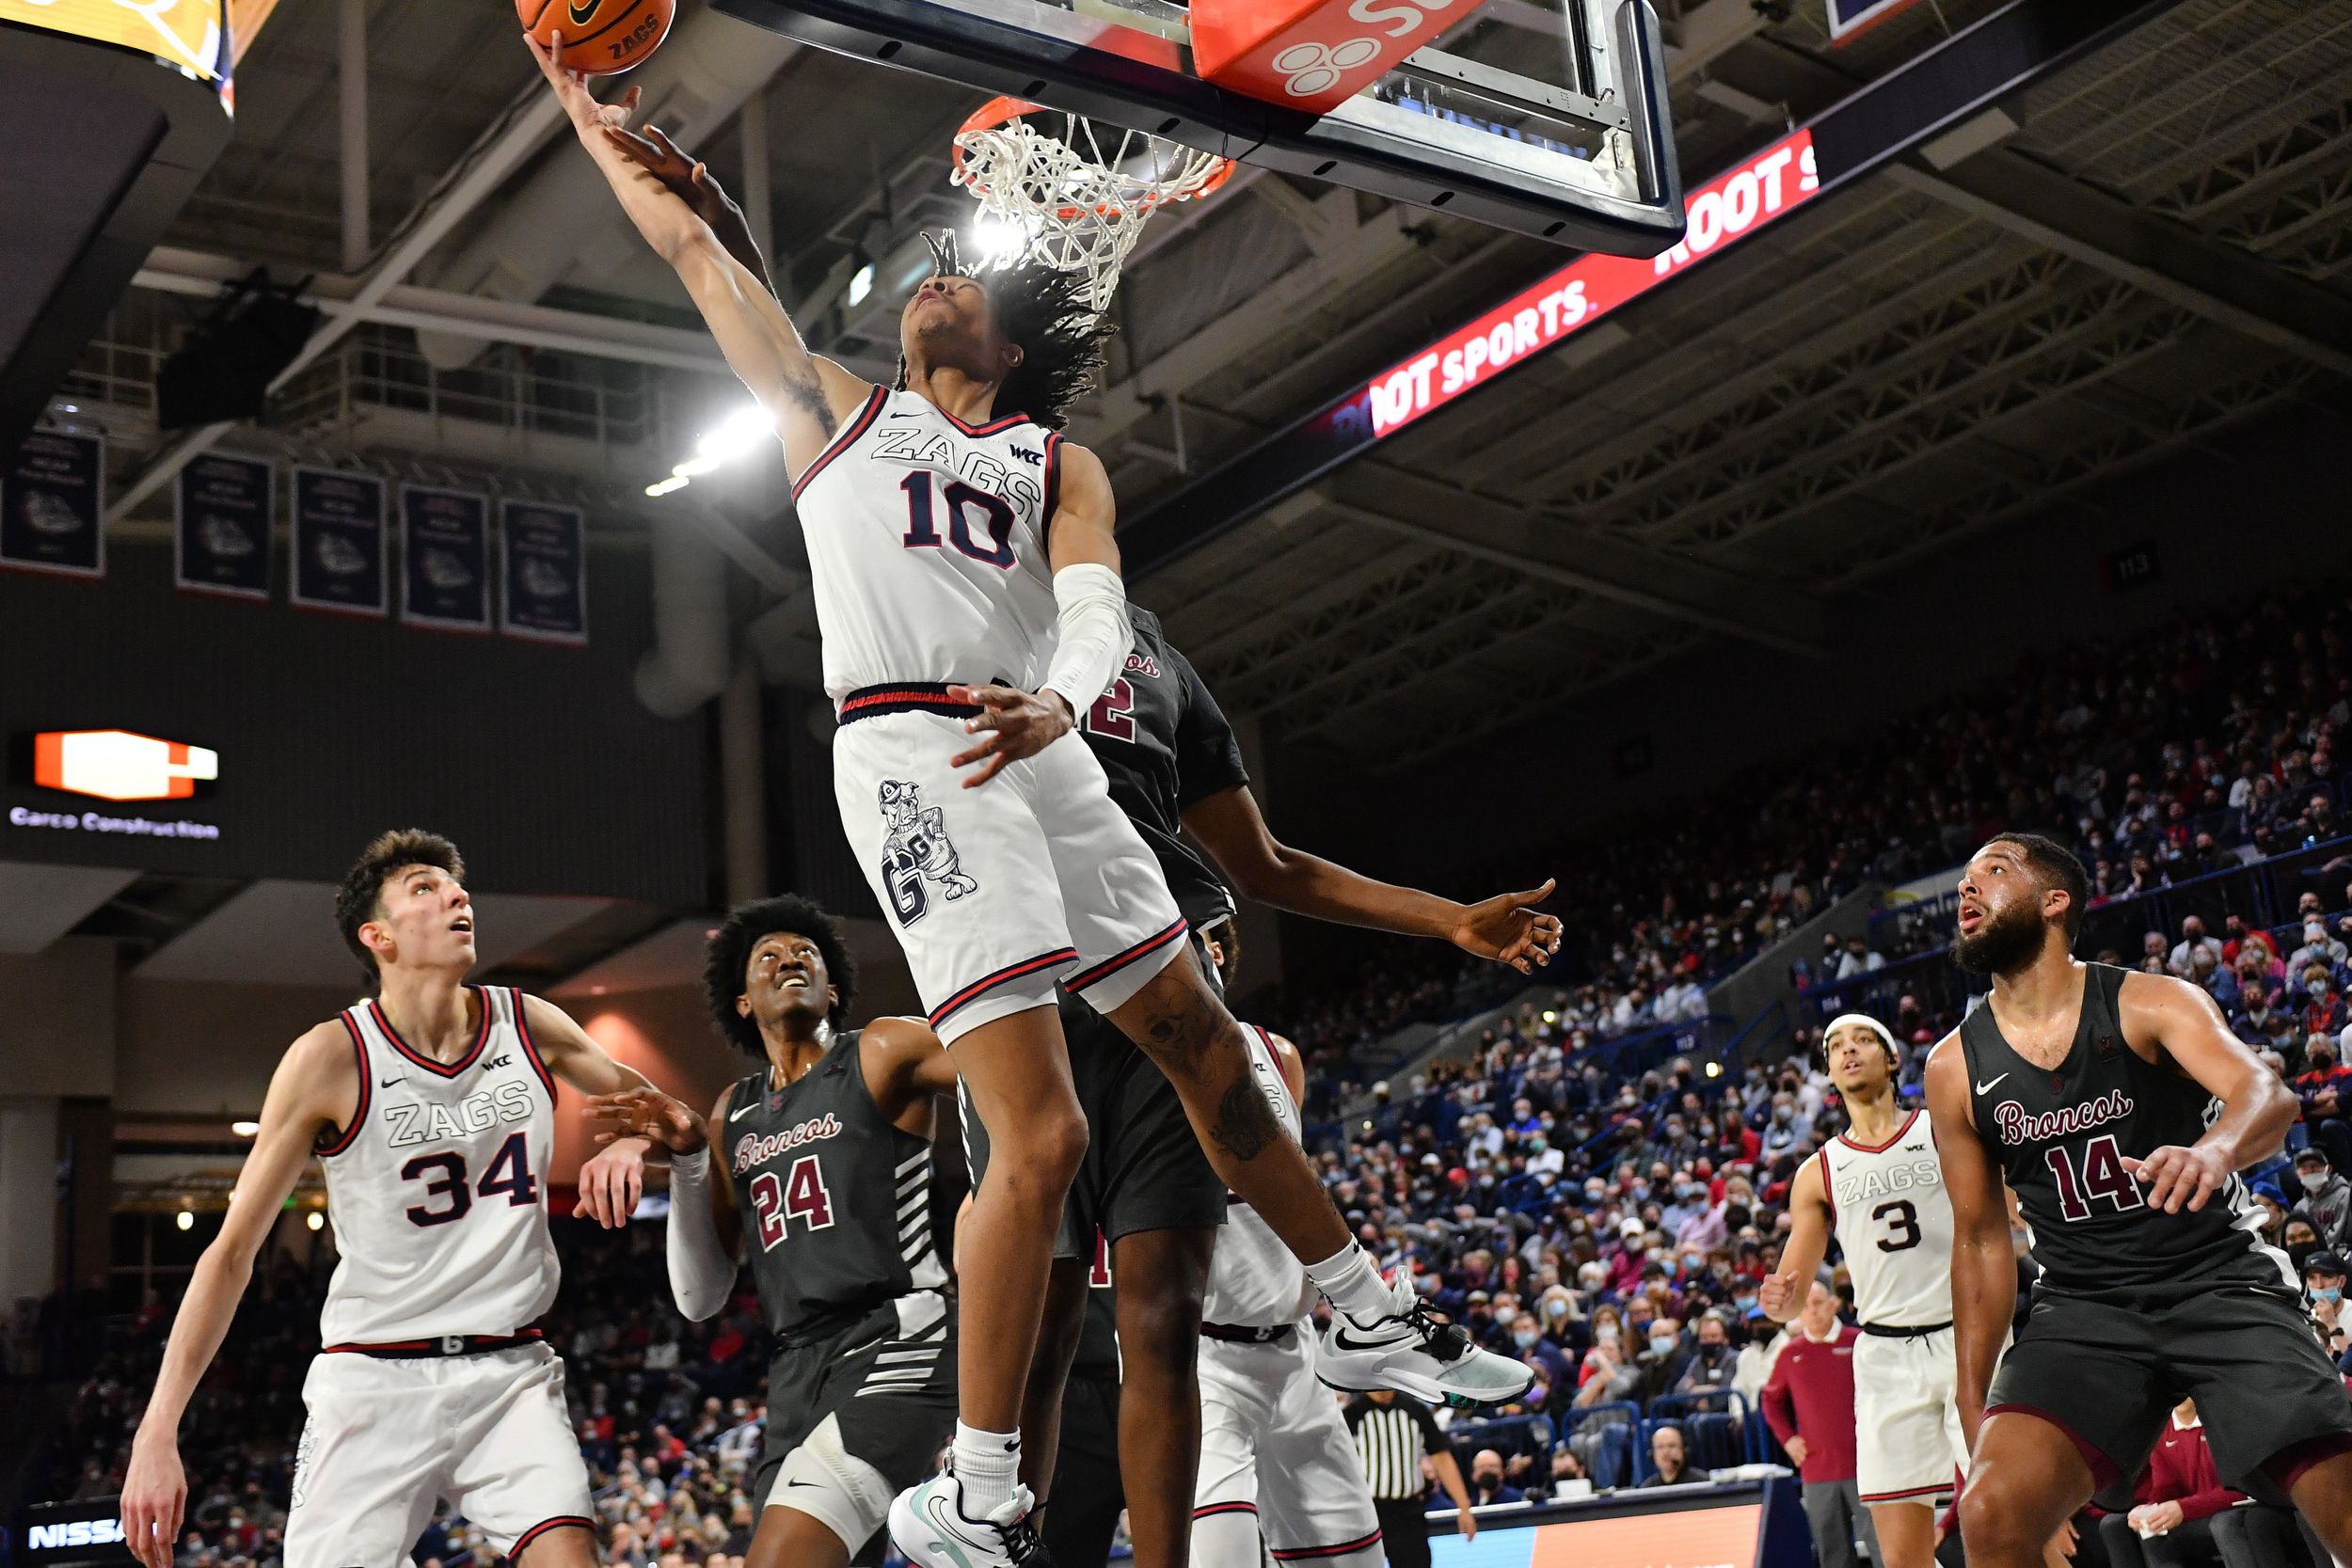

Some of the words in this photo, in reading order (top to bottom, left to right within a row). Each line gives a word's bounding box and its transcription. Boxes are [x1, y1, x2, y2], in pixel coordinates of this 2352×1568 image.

[607, 15, 659, 59] ZAGS
[871, 428, 1041, 524] ZAGS
[1009, 443, 1045, 467] WCC
[899, 469, 1017, 571] 10
[1077, 676, 1136, 745] 2
[81, 812, 220, 839] Construction
[907, 833, 930, 857] G
[882, 848, 929, 928] G
[482, 1054, 513, 1071] WCC
[385, 1080, 534, 1148] ZAGS
[732, 1113, 842, 1178] Broncos
[1994, 1089, 2134, 1145] Broncos
[401, 1131, 538, 1227] 34
[750, 1154, 835, 1253] 24
[1837, 1159, 1940, 1209] ZAGS
[2044, 1134, 2144, 1222] 14
[1872, 1199, 1922, 1253] 3
